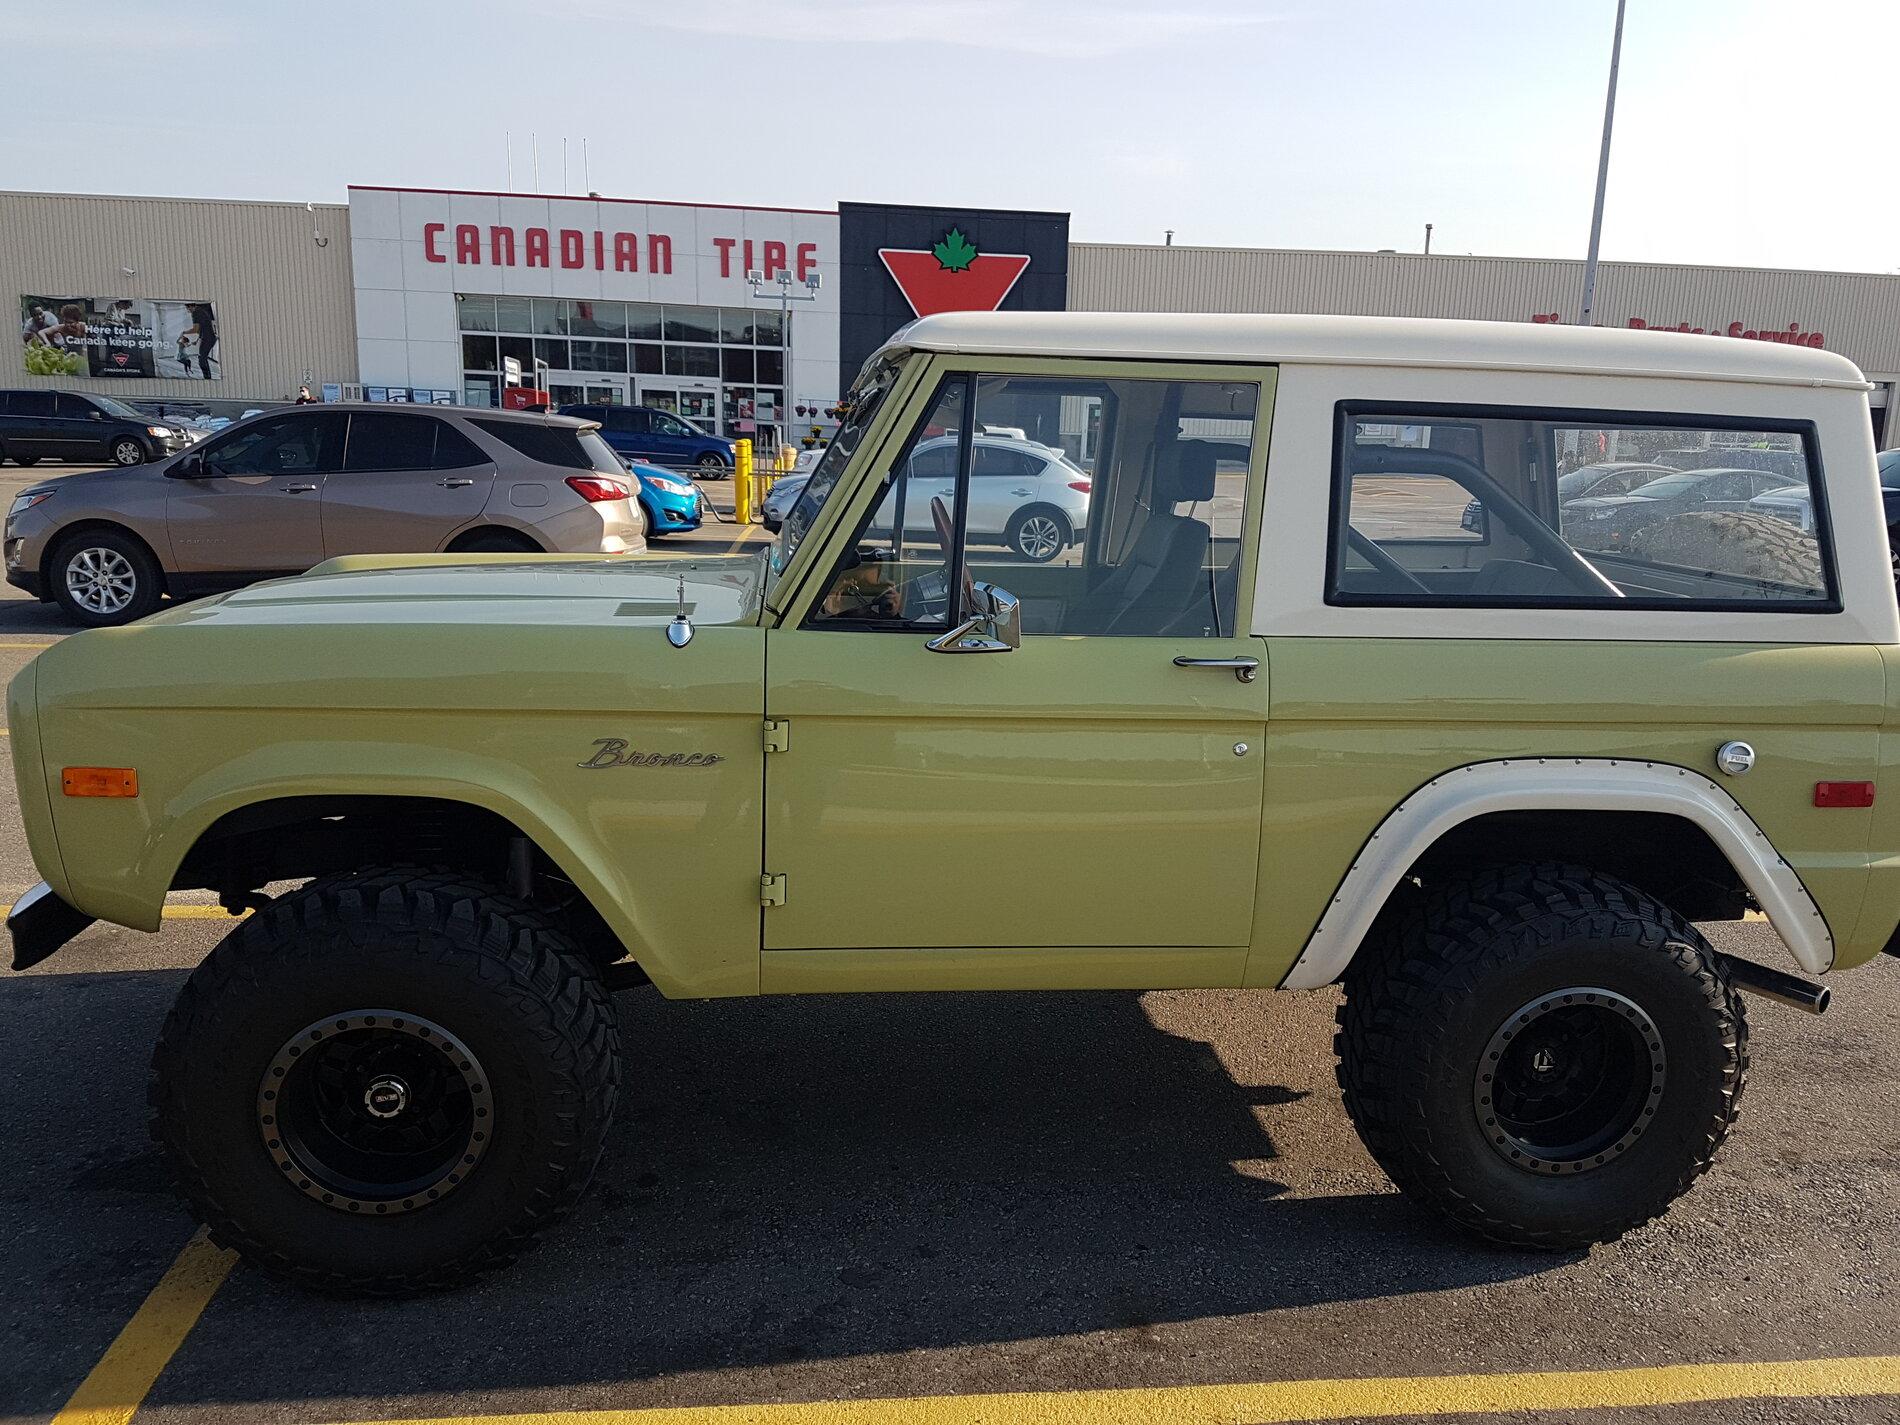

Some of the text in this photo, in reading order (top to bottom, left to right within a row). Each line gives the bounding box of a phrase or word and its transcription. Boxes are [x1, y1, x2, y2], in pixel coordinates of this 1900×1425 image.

[424, 223, 817, 282] CANADIAN TIRE
[66, 335, 173, 349] Canada keep gong.
[85, 325, 152, 337] Here to help
[576, 738, 727, 769] Bronco
